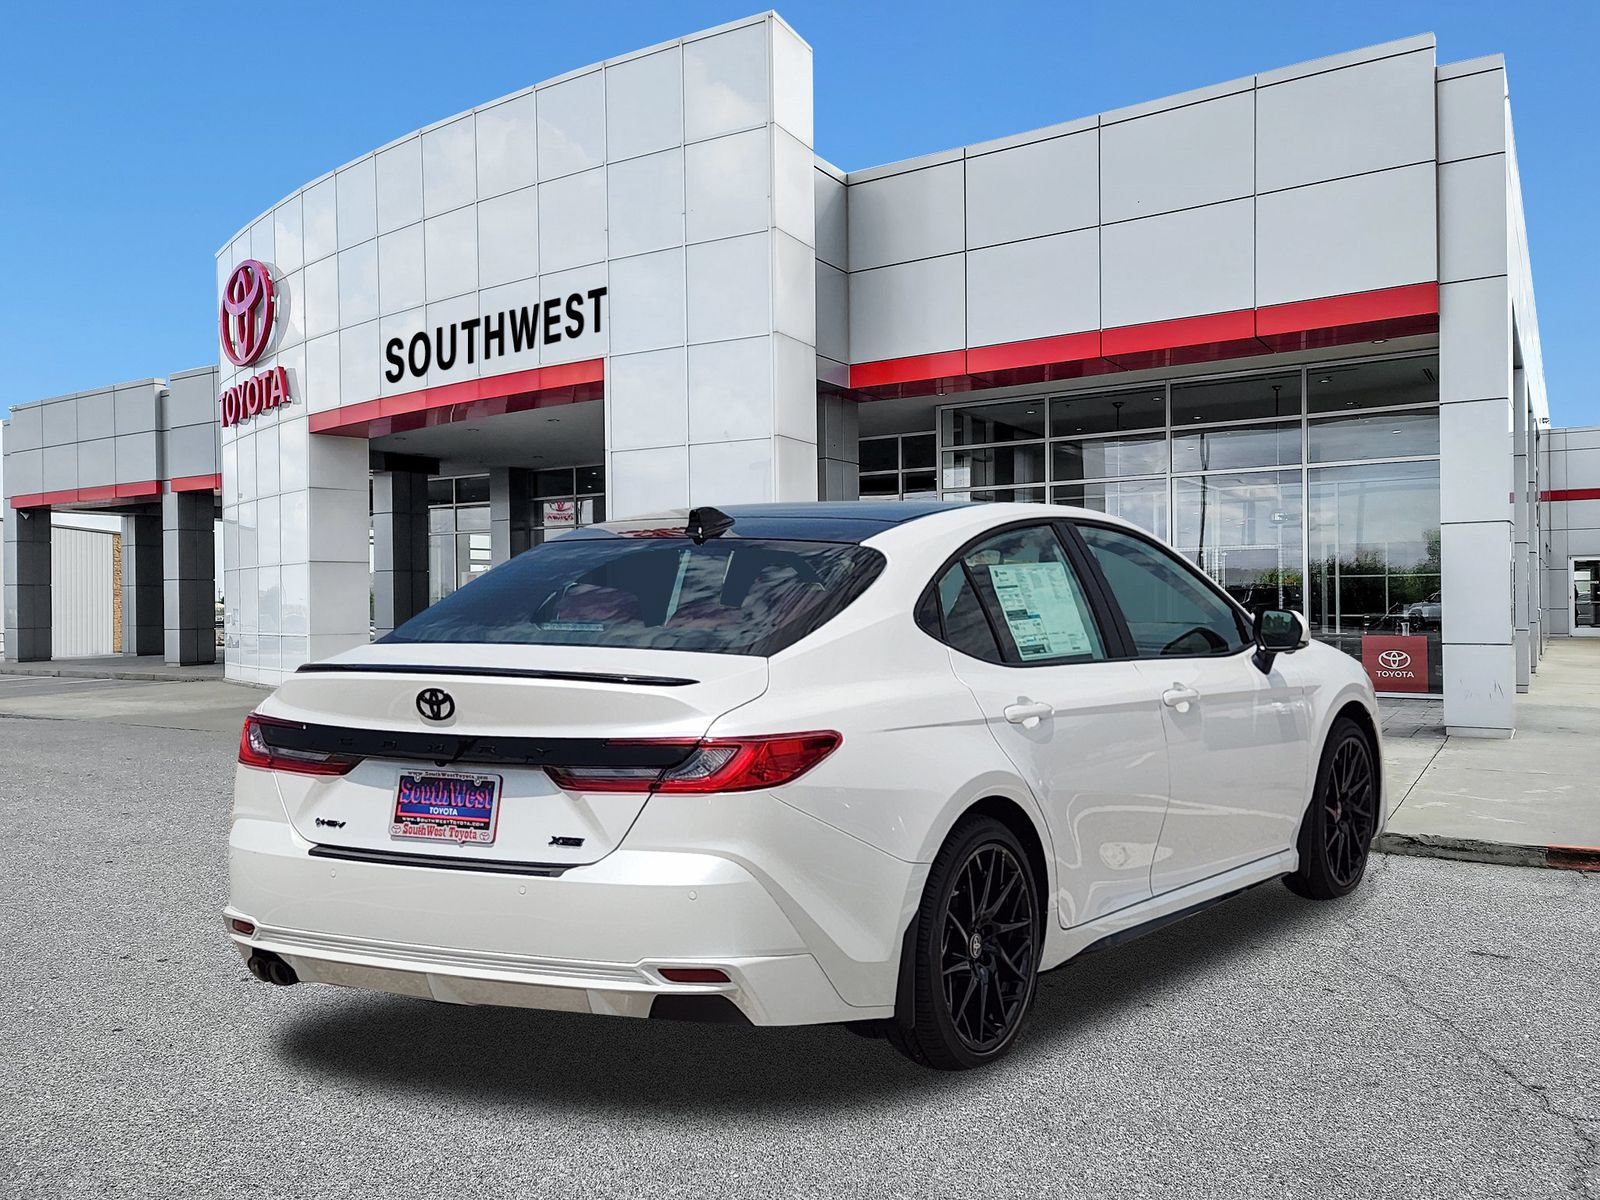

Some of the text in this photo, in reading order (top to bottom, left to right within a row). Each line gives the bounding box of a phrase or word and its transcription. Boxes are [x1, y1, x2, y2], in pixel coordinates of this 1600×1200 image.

[385, 286, 608, 384] SOUTHWEST
[218, 366, 291, 428] TOYOTA
[1376, 670, 1415, 678] TOYOTA
[429, 807, 458, 816] TOYOTA
[402, 823, 477, 841] SouthWest Toyota
